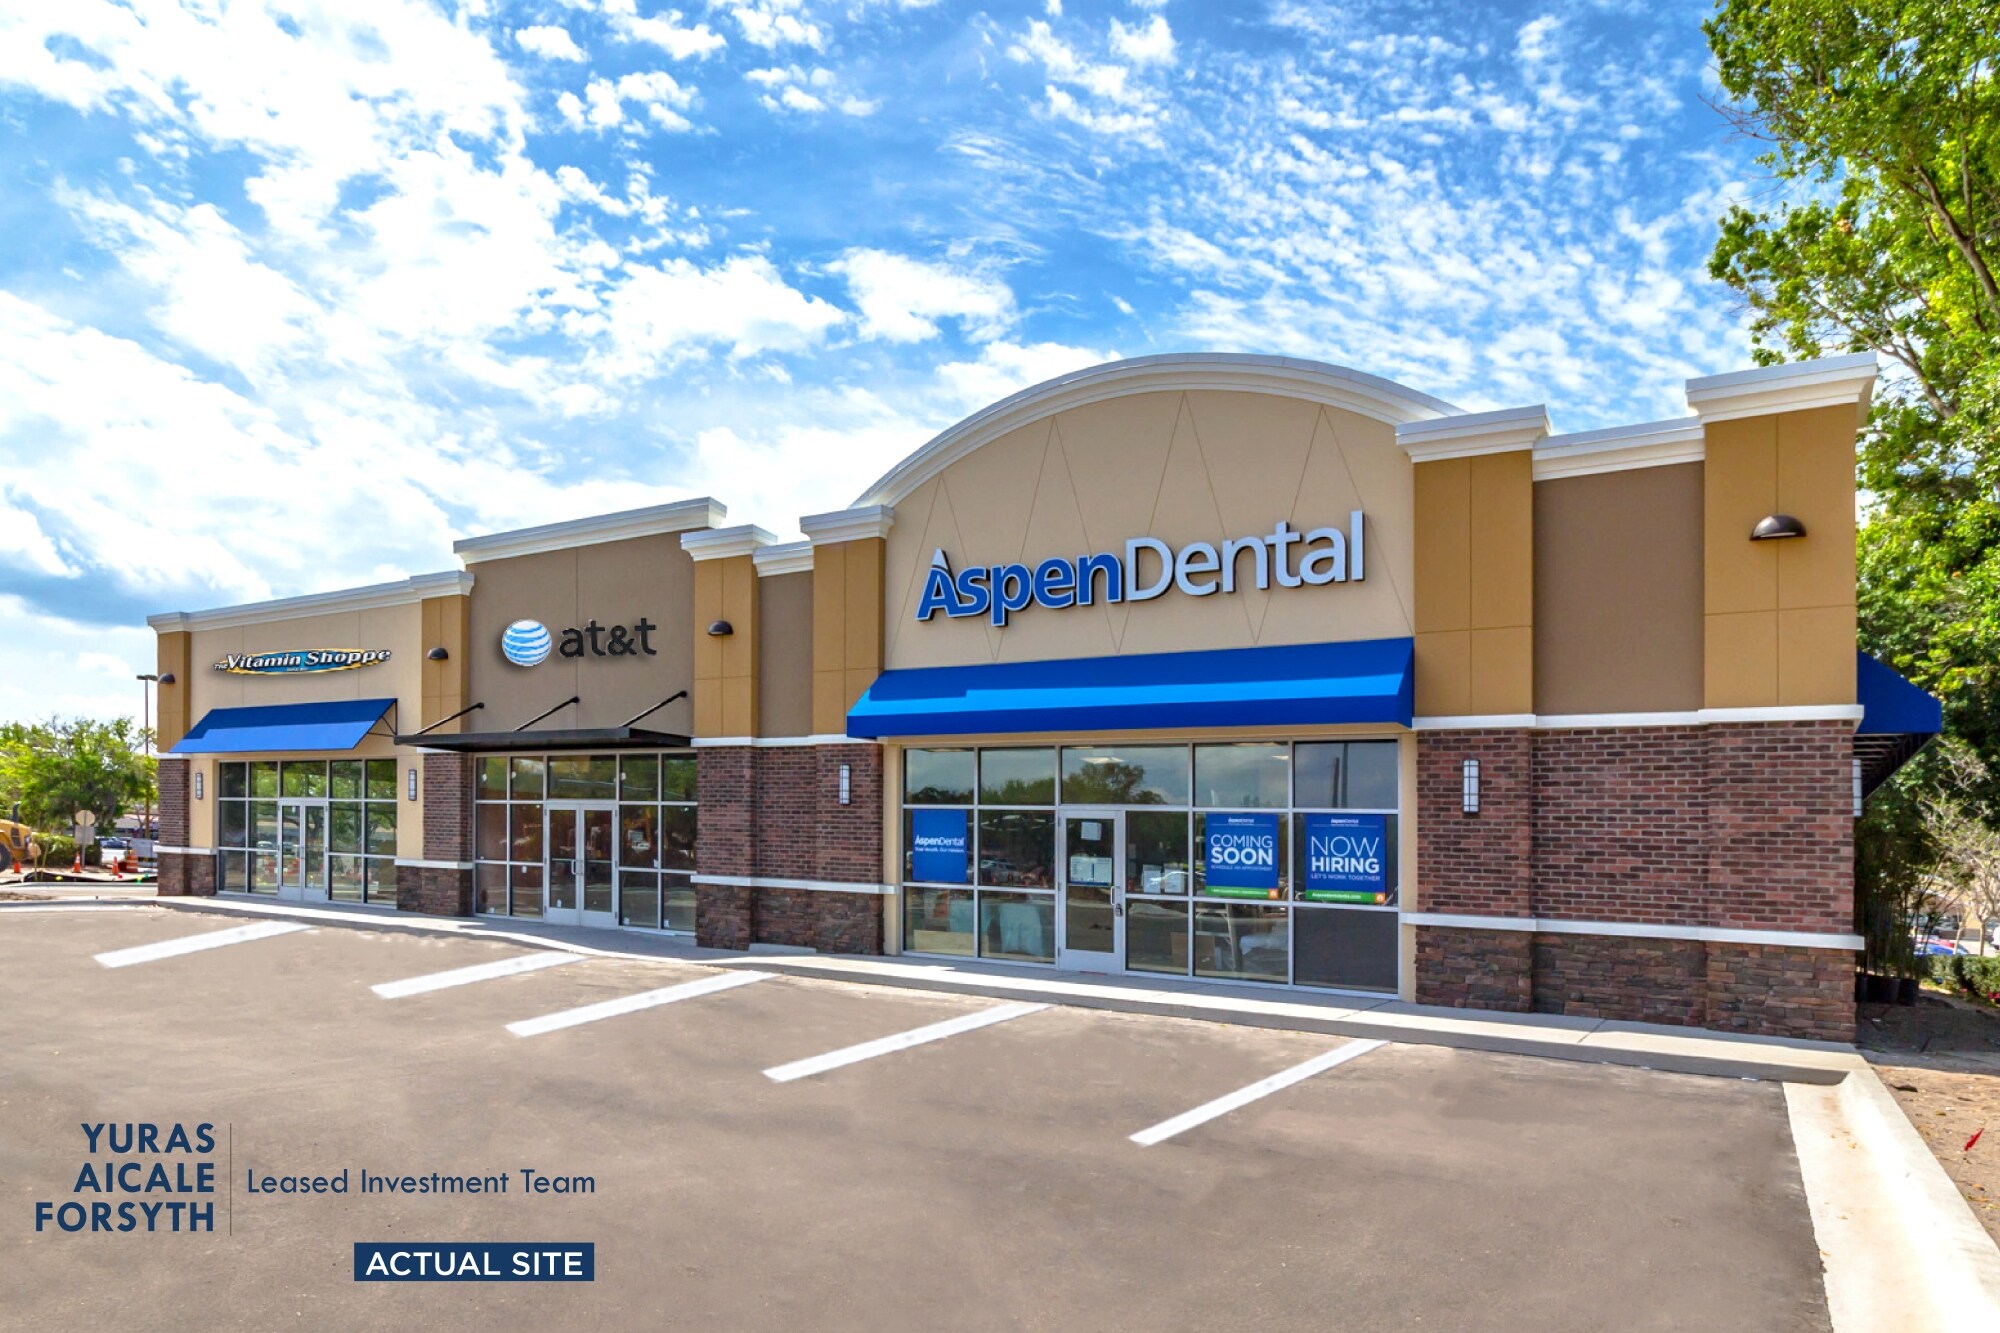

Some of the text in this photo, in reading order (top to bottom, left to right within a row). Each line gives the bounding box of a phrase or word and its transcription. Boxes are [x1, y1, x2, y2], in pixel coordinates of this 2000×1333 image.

[915, 509, 1365, 627] AspenDental
[559, 617, 658, 658] at&t
[226, 652, 302, 670] Vitamin
[303, 648, 390, 667] Shoppe
[914, 834, 964, 846] AspenDental
[1210, 833, 1273, 849] COMING
[1311, 835, 1380, 857] NOW
[1210, 847, 1273, 866] SOON
[1311, 856, 1380, 874] HIRING
